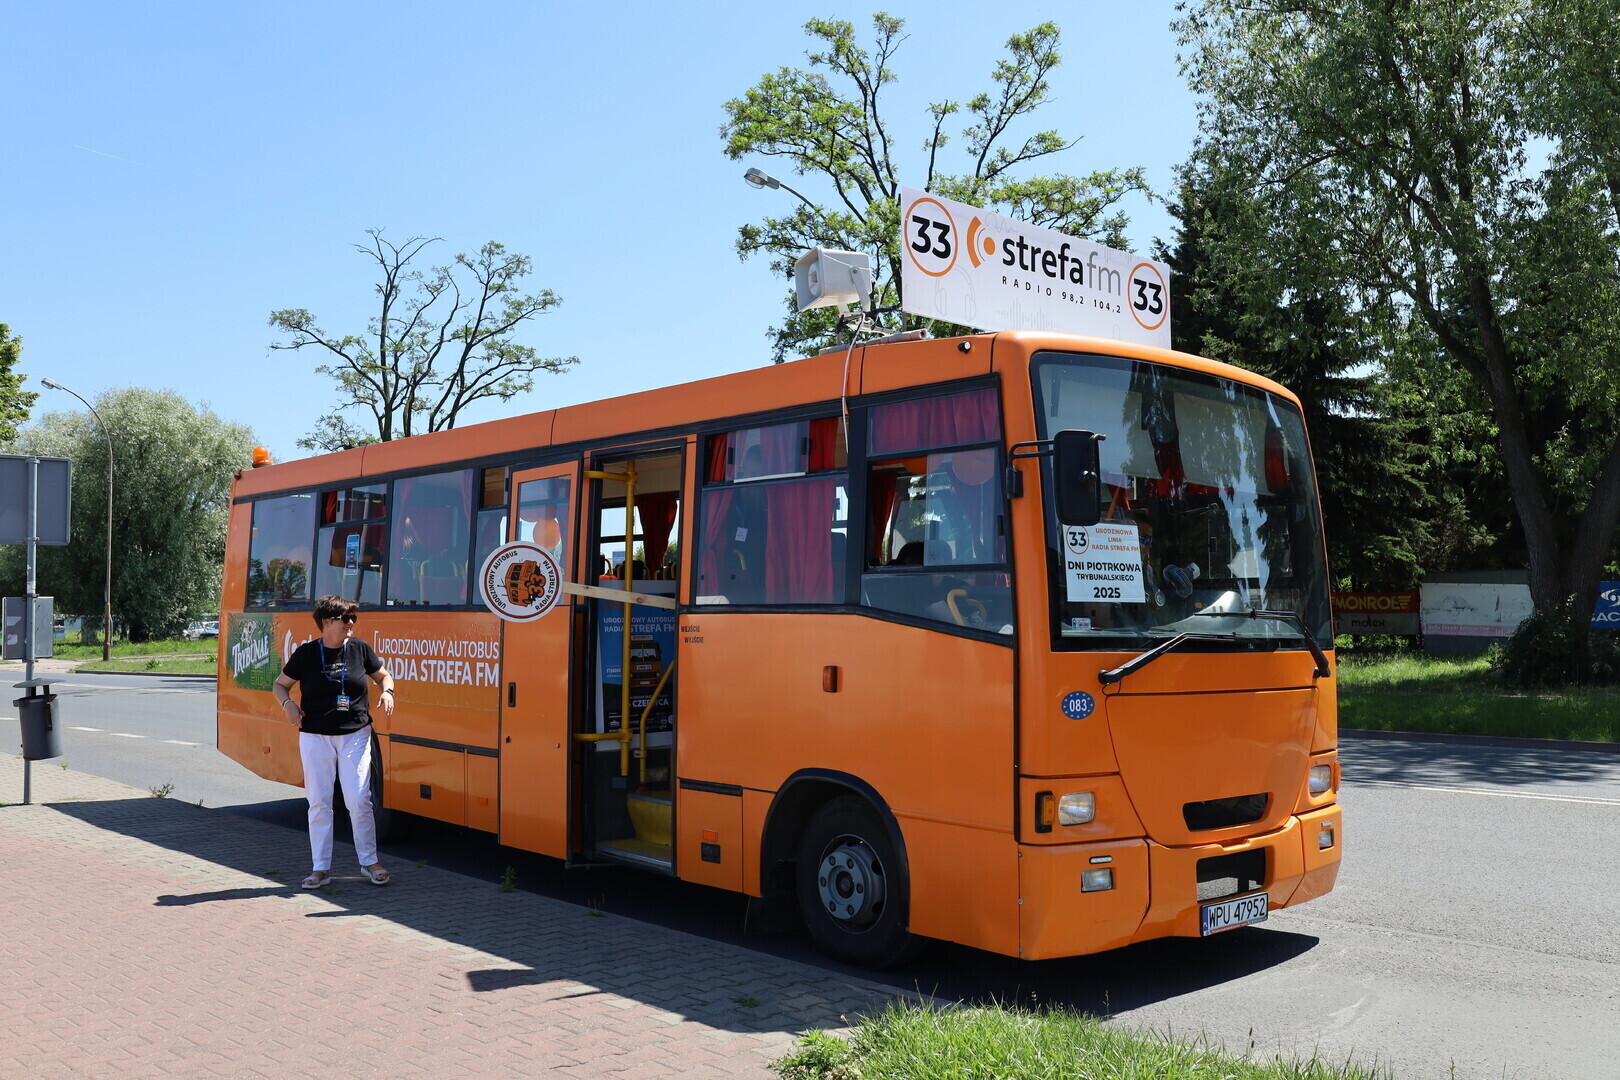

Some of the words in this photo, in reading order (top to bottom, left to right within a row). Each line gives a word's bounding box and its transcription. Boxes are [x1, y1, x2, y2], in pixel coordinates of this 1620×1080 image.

[911, 215, 951, 259] 33
[1002, 275, 1052, 296] RADIO
[1133, 278, 1163, 315] 33
[1069, 532, 1086, 546] 33
[493, 550, 518, 570] AUTOBUS
[543, 560, 552, 570] FM
[1068, 561, 1085, 570] DNI
[1087, 562, 1141, 572] PIOTRKOWA
[548, 569, 556, 594] STREFA
[1077, 573, 1135, 581] TRYBUNALSKIEGO
[488, 571, 507, 610] URODZINOWY
[1093, 587, 1121, 598] 2025
[535, 594, 552, 611] RADIA
[1335, 595, 1401, 610] MONROE
[378, 638, 446, 657] URODZINOWY
[447, 641, 499, 659] AUTOBUS
[420, 659, 473, 686] STREFA
[476, 662, 499, 688] FM
[632, 698, 669, 708] CZECA
[1069, 699, 1087, 712] 083
[1209, 904, 1231, 928] WPU
[1233, 897, 1266, 922] 47952
